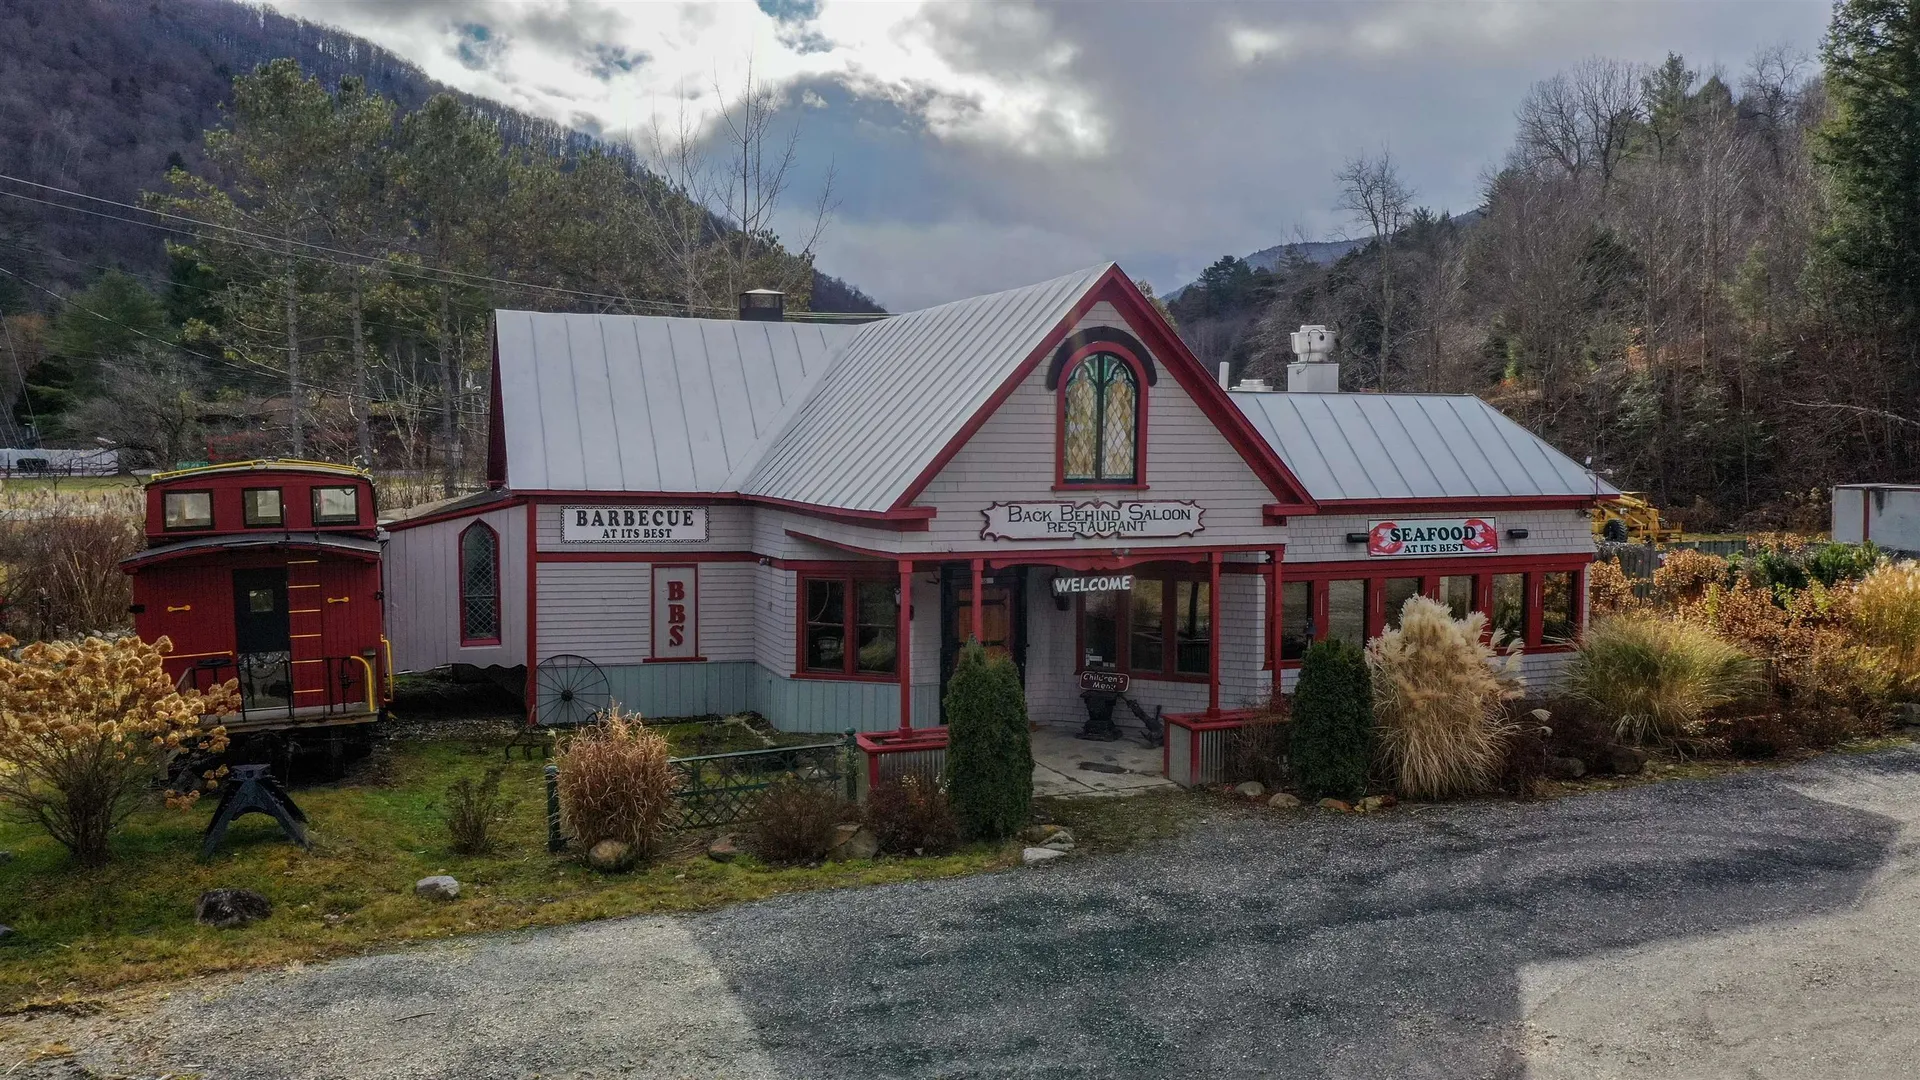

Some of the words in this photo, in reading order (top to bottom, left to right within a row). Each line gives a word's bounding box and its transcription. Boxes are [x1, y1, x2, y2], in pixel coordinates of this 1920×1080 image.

[576, 510, 694, 526] BARBECUE
[1008, 506, 1051, 522] BACK
[1060, 505, 1121, 521] BEHIND
[1128, 504, 1191, 520] SALOON
[602, 529, 617, 539] AT
[621, 529, 640, 539] ITS
[643, 529, 672, 539] BEST
[1047, 521, 1147, 533] RESTAURANT
[1390, 526, 1476, 542] SEAFOOD
[1404, 545, 1418, 553] AT
[1420, 544, 1437, 553] ITS
[1439, 542, 1465, 552] BEST
[1055, 576, 1131, 592] WELCOME
